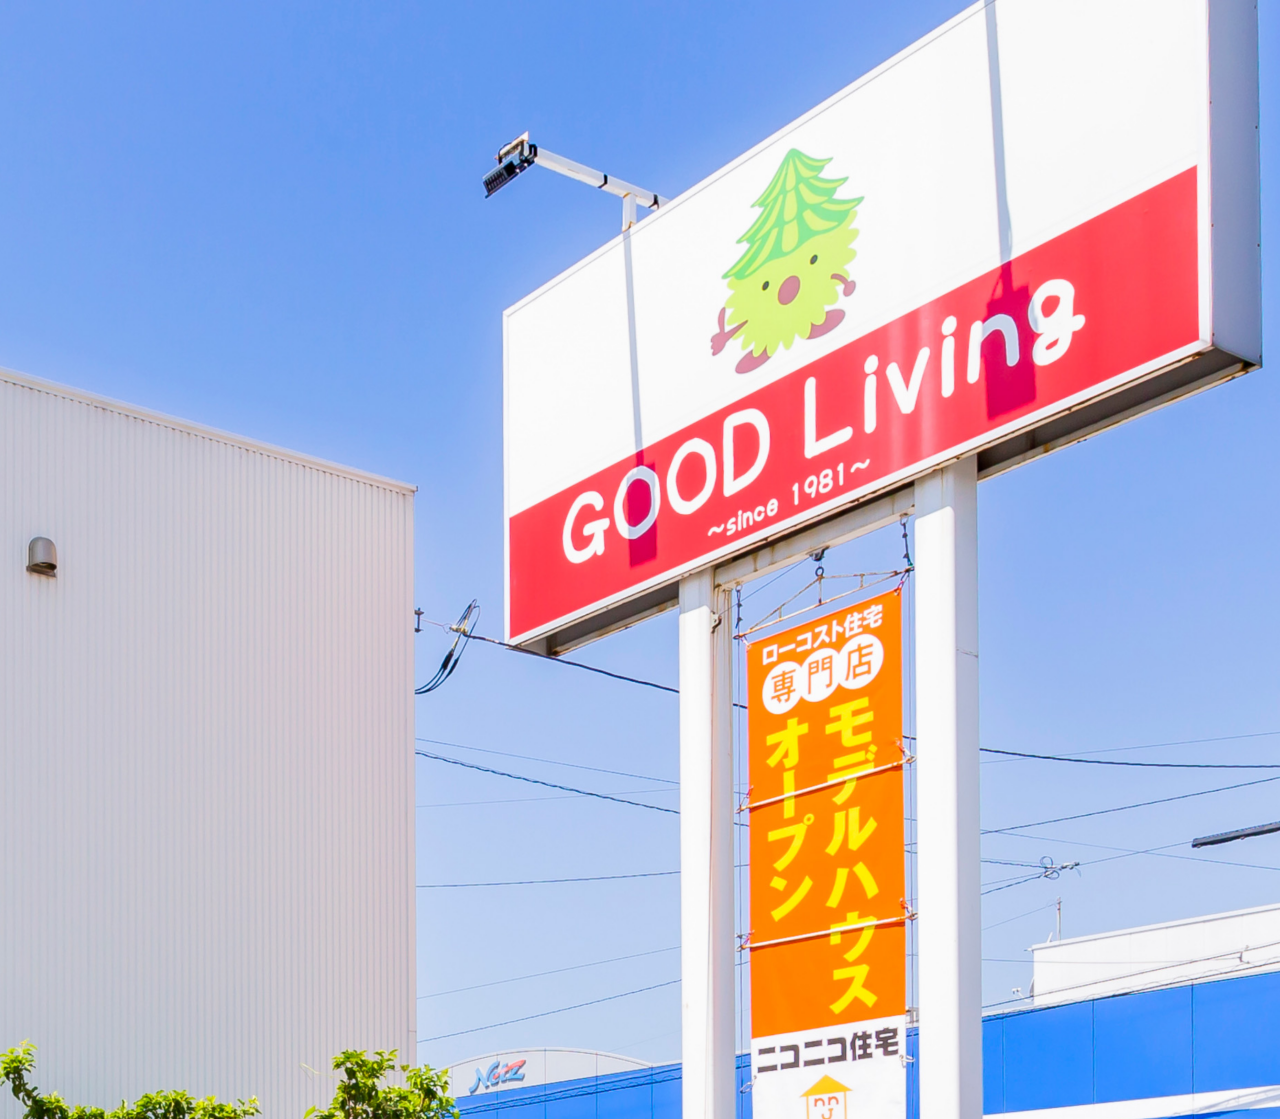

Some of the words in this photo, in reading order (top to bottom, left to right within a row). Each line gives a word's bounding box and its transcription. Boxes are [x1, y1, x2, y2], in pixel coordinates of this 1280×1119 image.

[561, 408, 771, 564] GOOD
[804, 278, 1086, 459] Living
[762, 604, 883, 666] ローコスト住宅
[770, 642, 874, 704] 専門店
[766, 717, 815, 922] オープン
[825, 696, 879, 1015] モデルハウス
[757, 1027, 899, 1074] ニコニコ住宅
